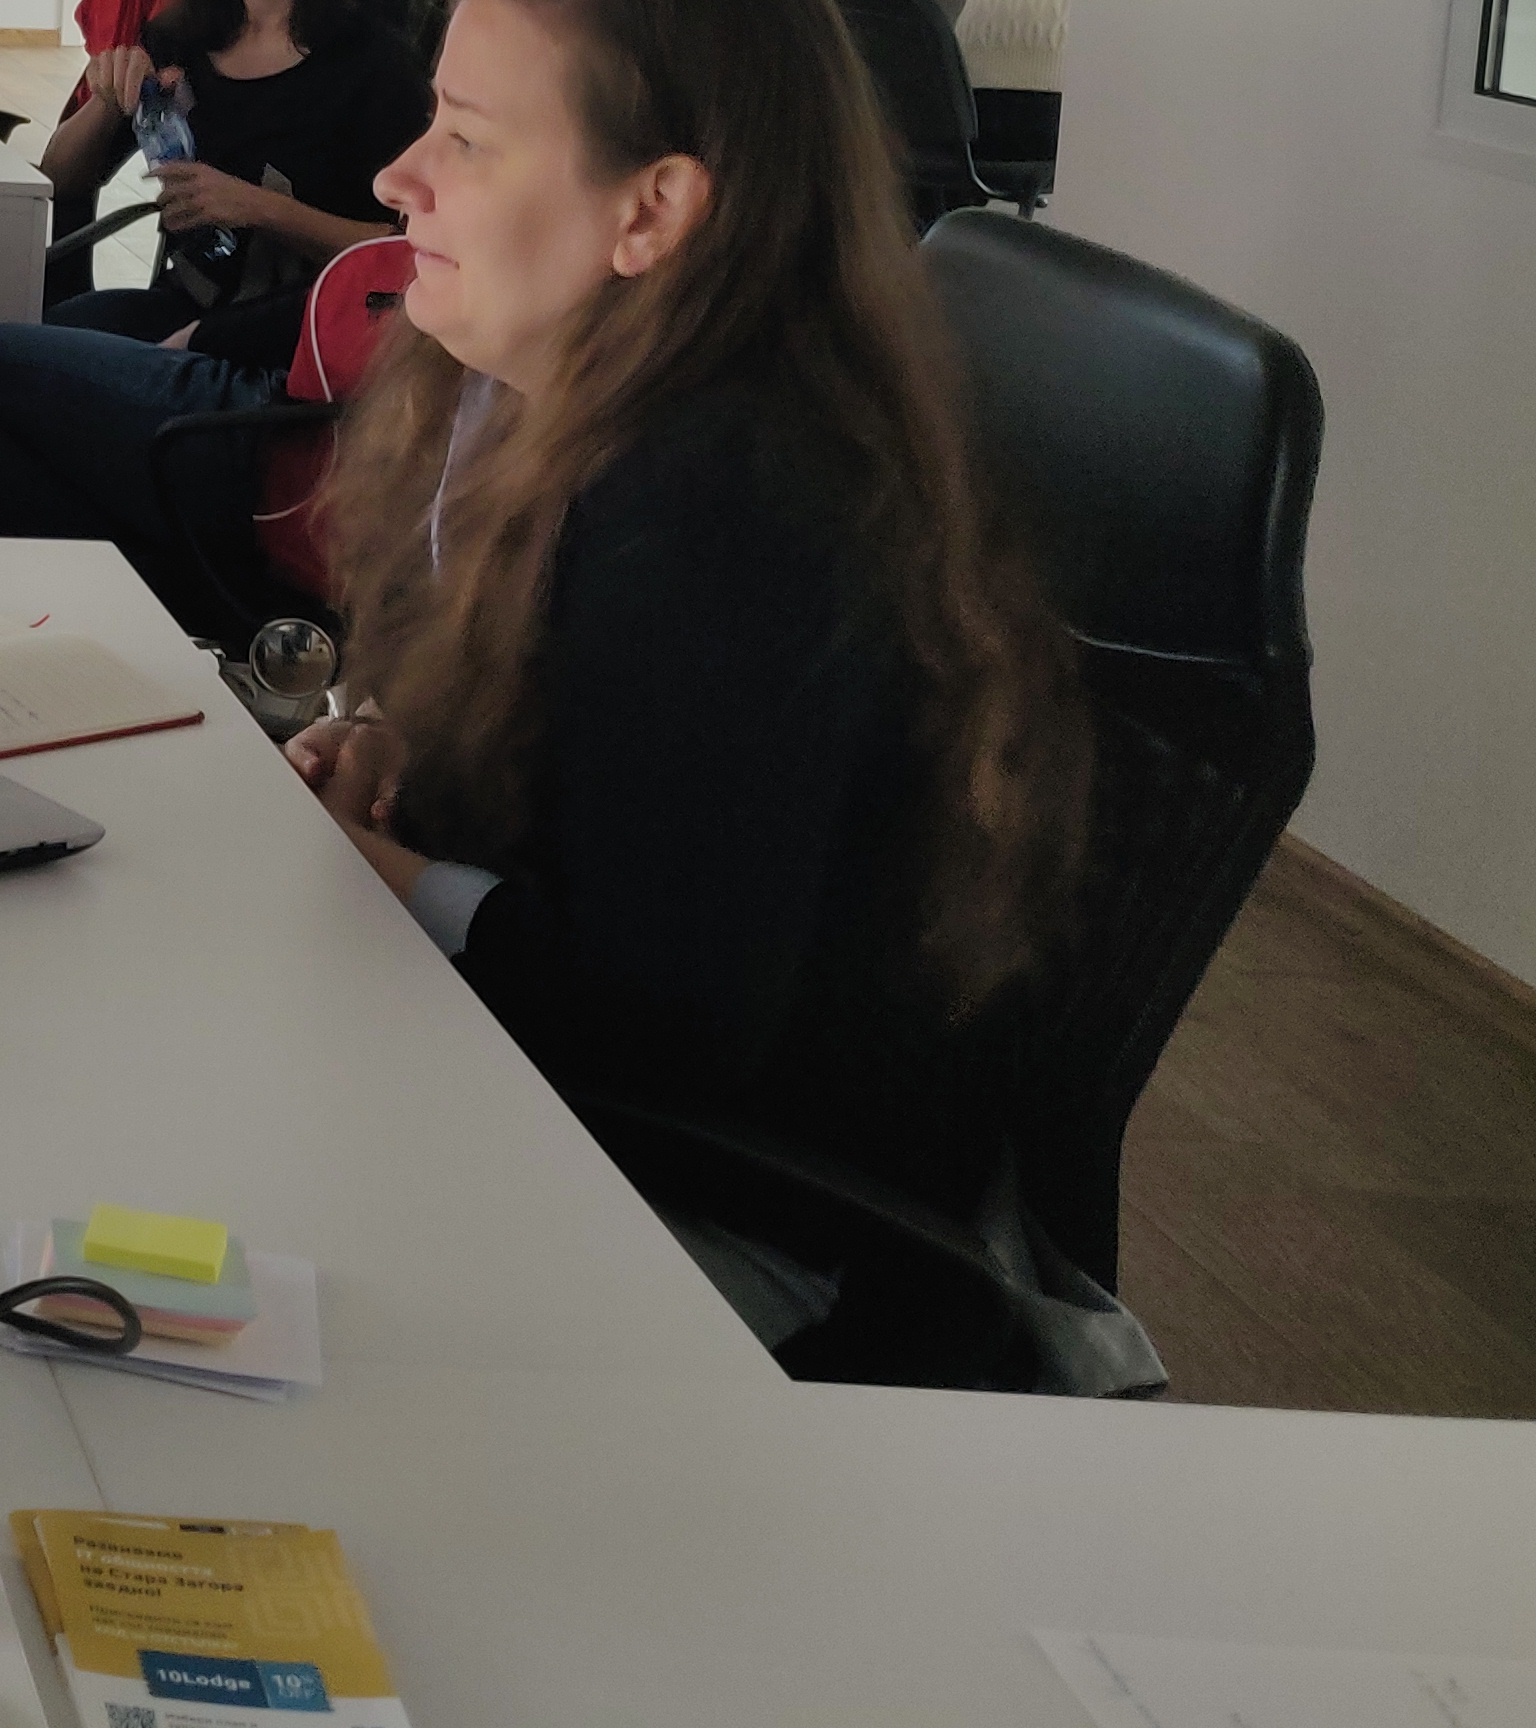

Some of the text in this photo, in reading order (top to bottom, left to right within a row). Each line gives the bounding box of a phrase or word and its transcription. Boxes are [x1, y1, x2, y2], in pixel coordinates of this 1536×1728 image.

[109, 1567, 168, 1585] Стара
[176, 1576, 244, 1593] Загора
[156, 1668, 252, 1692] 10Lodge
